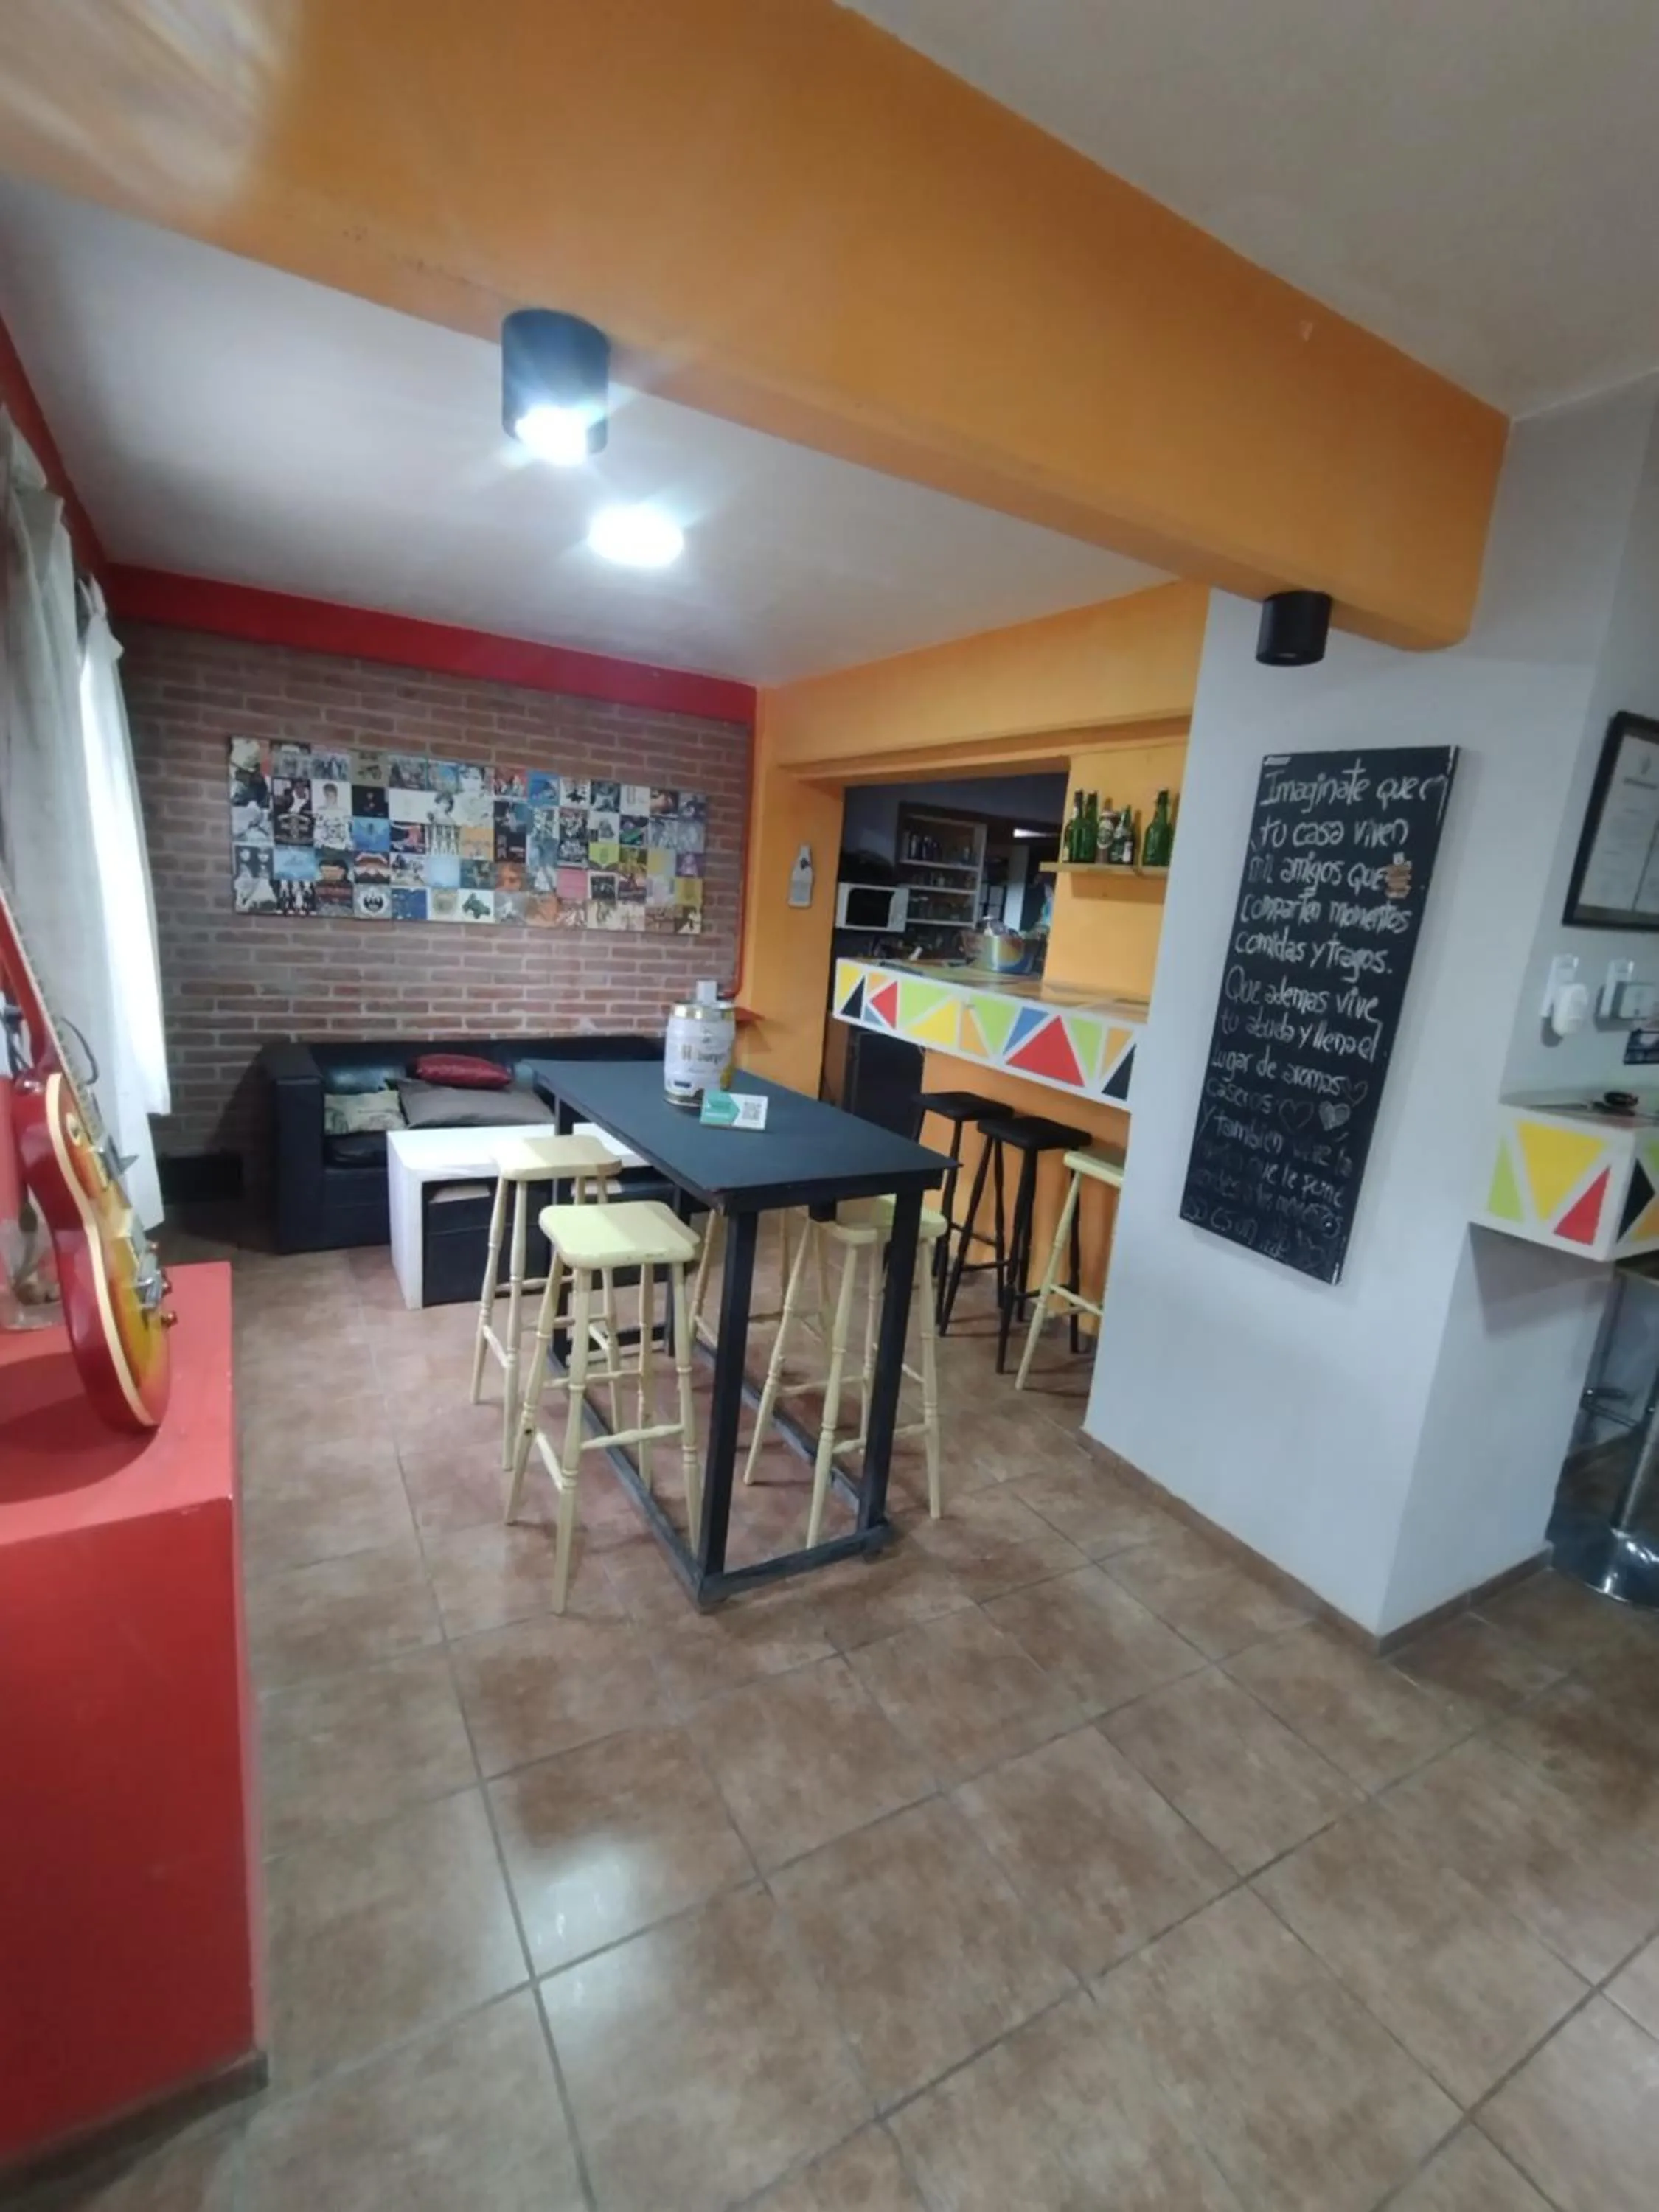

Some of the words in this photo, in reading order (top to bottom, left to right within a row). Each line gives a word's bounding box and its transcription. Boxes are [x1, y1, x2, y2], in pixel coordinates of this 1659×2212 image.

[1259, 757, 1371, 814] Imaginate
[1260, 815, 1287, 848] tu
[1293, 820, 1345, 846] casa
[1279, 849, 1345, 894] amigos
[1234, 925, 1307, 963] comidas
[1310, 941, 1326, 969] y
[1256, 1044, 1278, 1079] de
